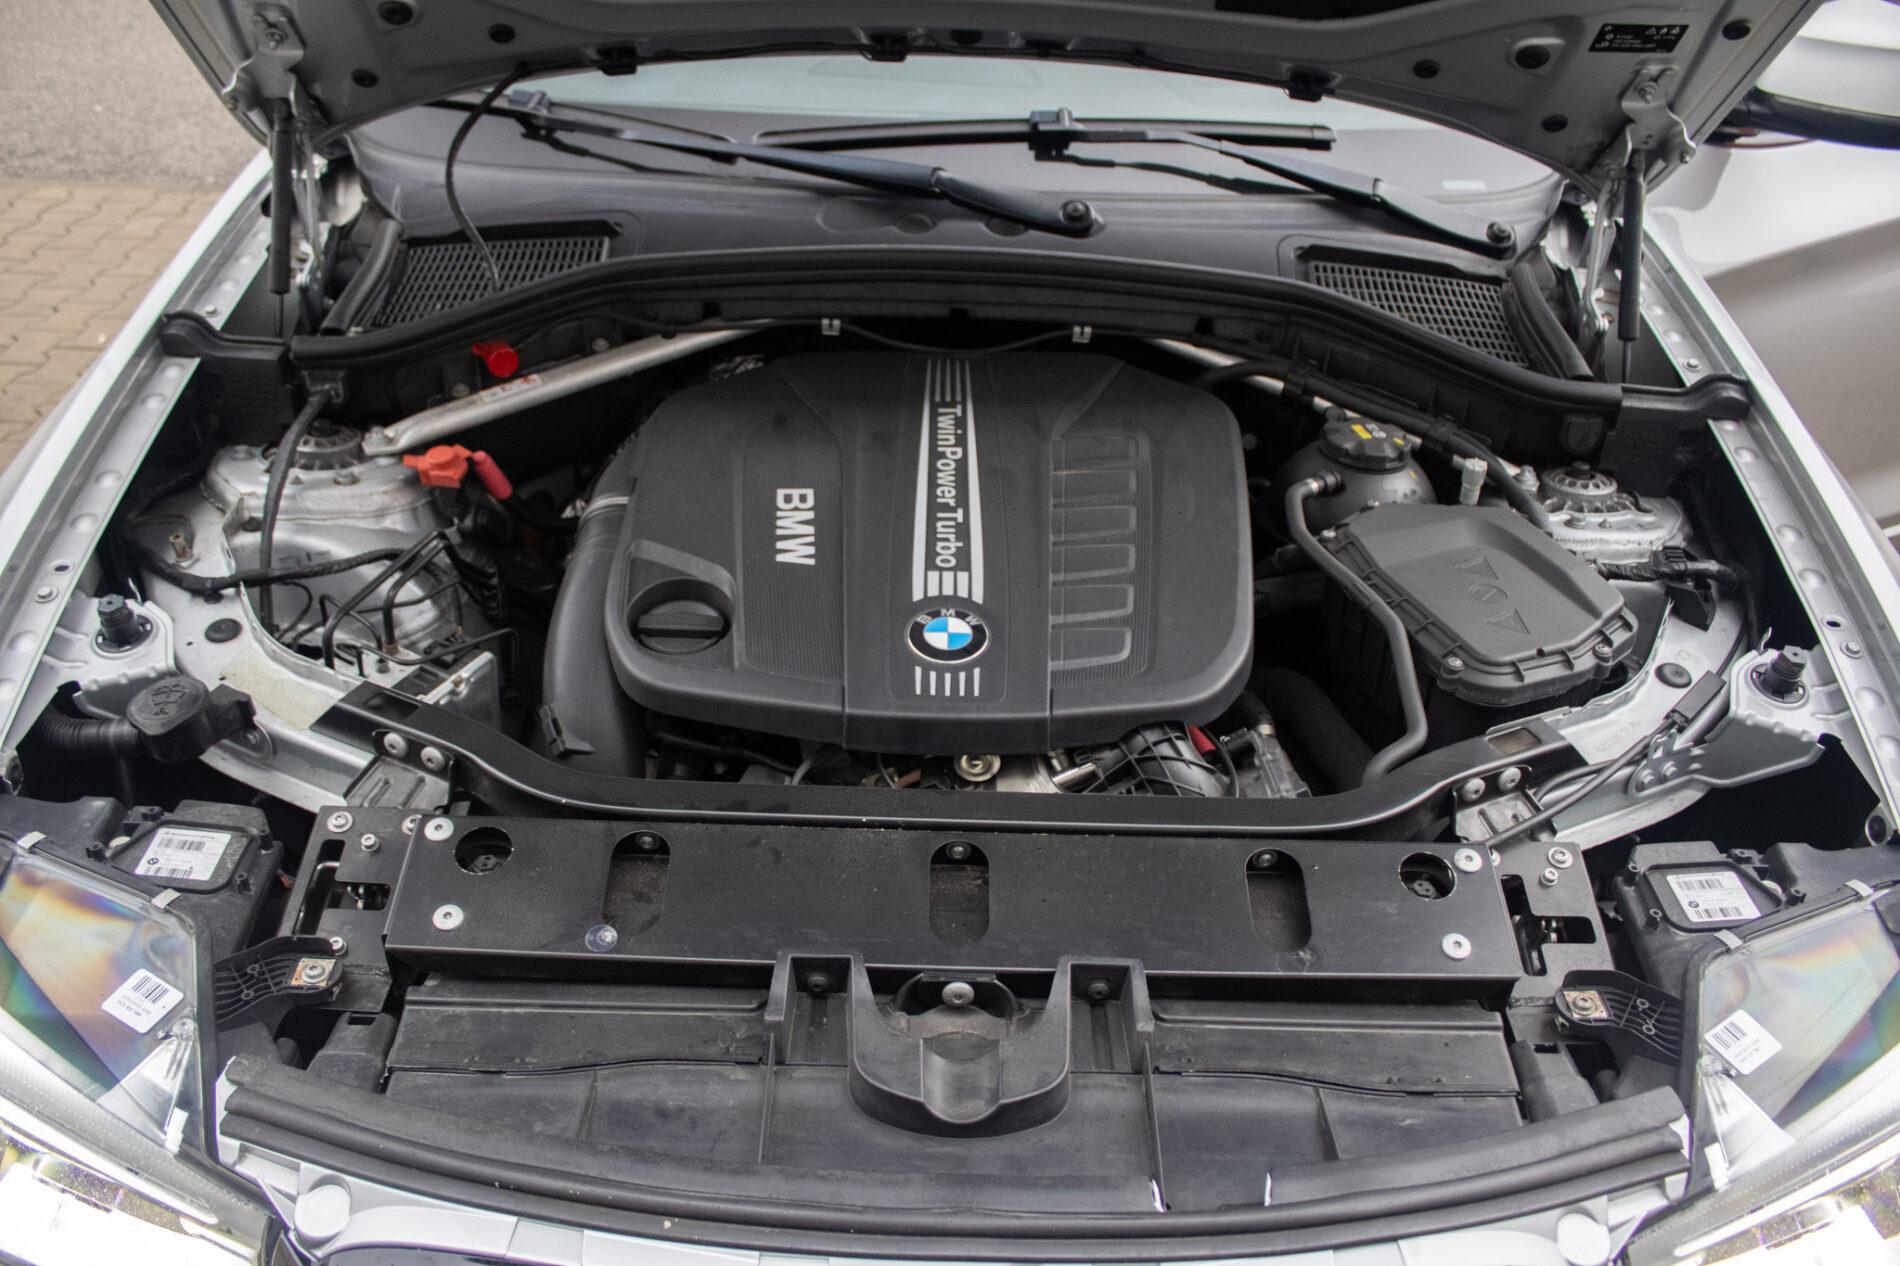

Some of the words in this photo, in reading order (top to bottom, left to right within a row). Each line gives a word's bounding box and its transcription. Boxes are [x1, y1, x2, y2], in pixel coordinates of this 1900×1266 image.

[936, 404, 963, 507] TwinPower
[776, 488, 815, 565] BMW
[935, 508, 964, 568] Turbo
[916, 608, 981, 625] BMW
